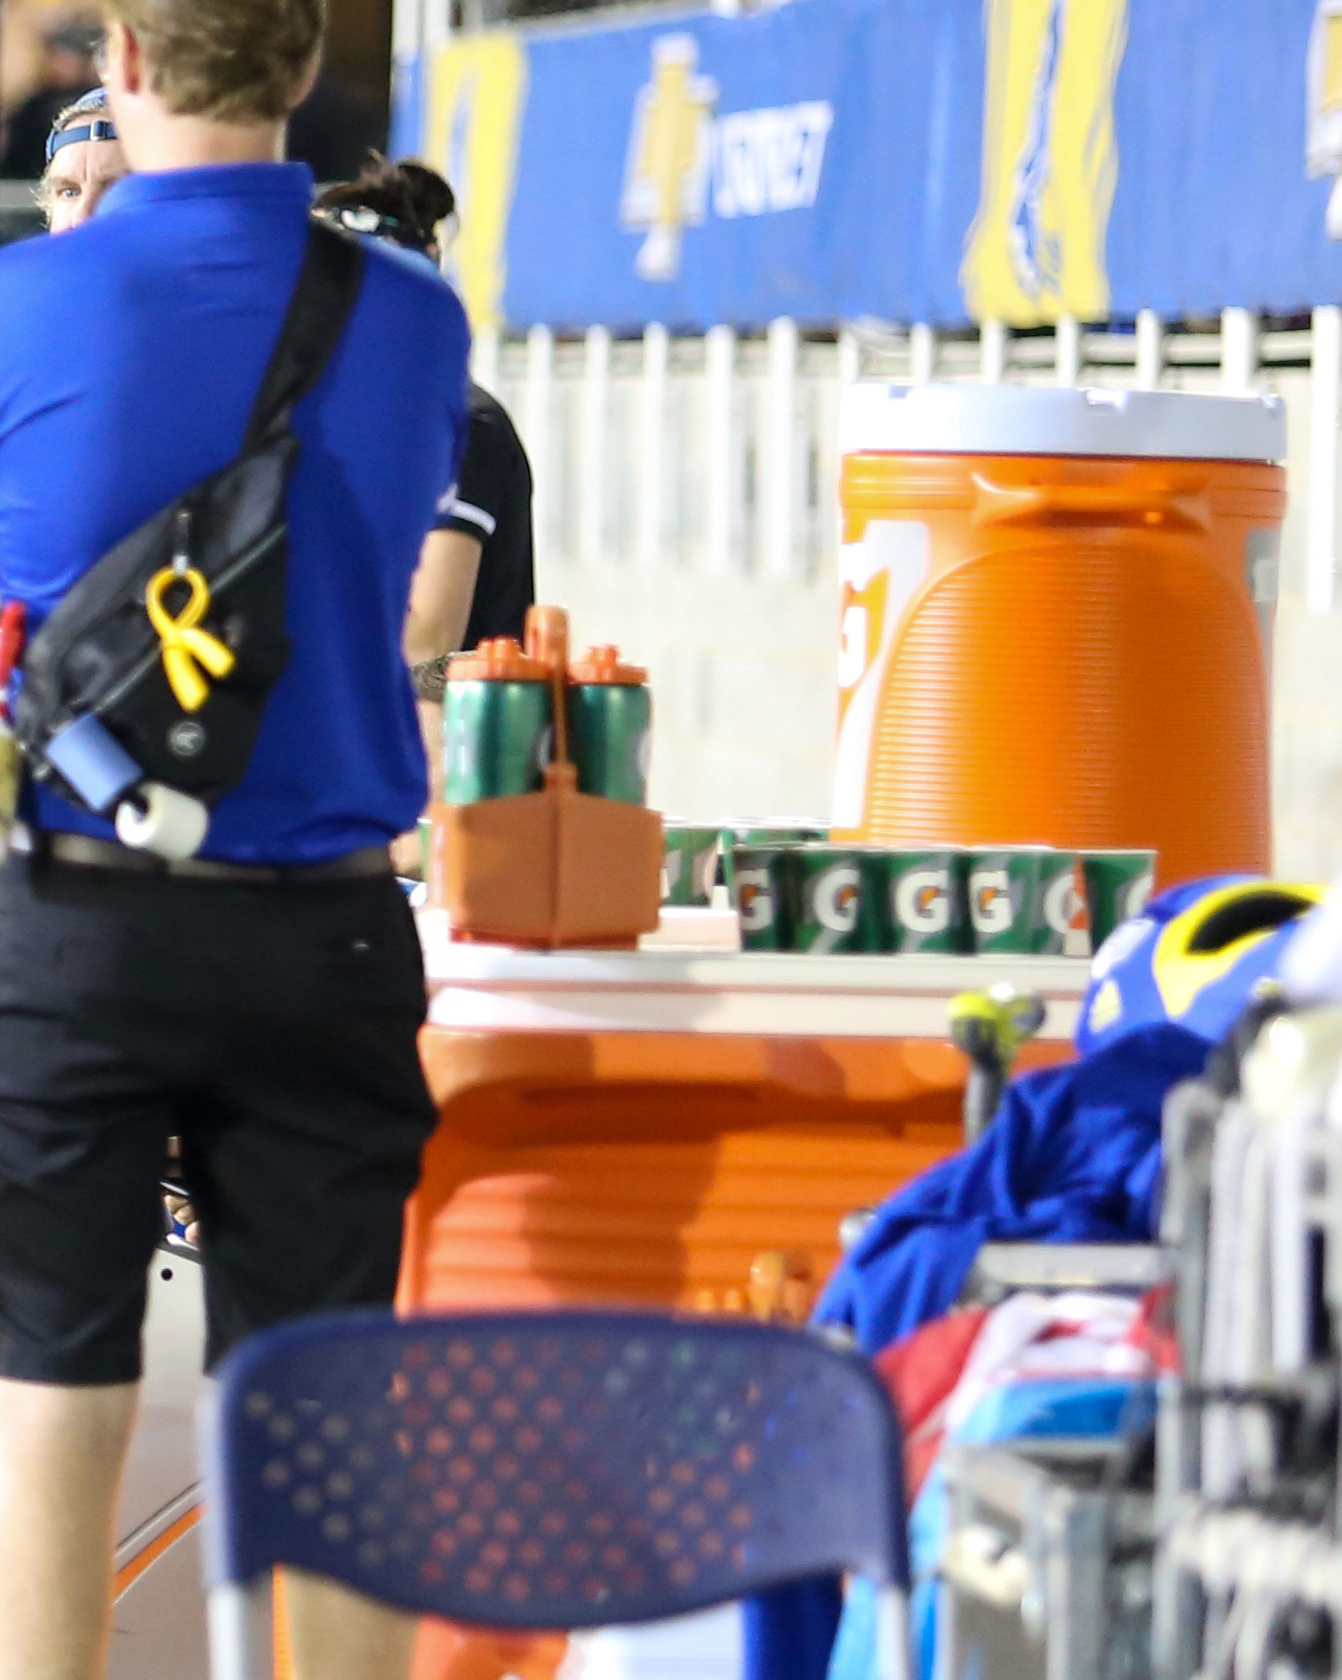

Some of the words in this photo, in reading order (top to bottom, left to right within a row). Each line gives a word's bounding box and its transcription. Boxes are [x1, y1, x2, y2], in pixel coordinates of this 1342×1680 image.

[813, 868, 860, 933] G
[896, 868, 949, 934] G
[969, 870, 1013, 933] G
